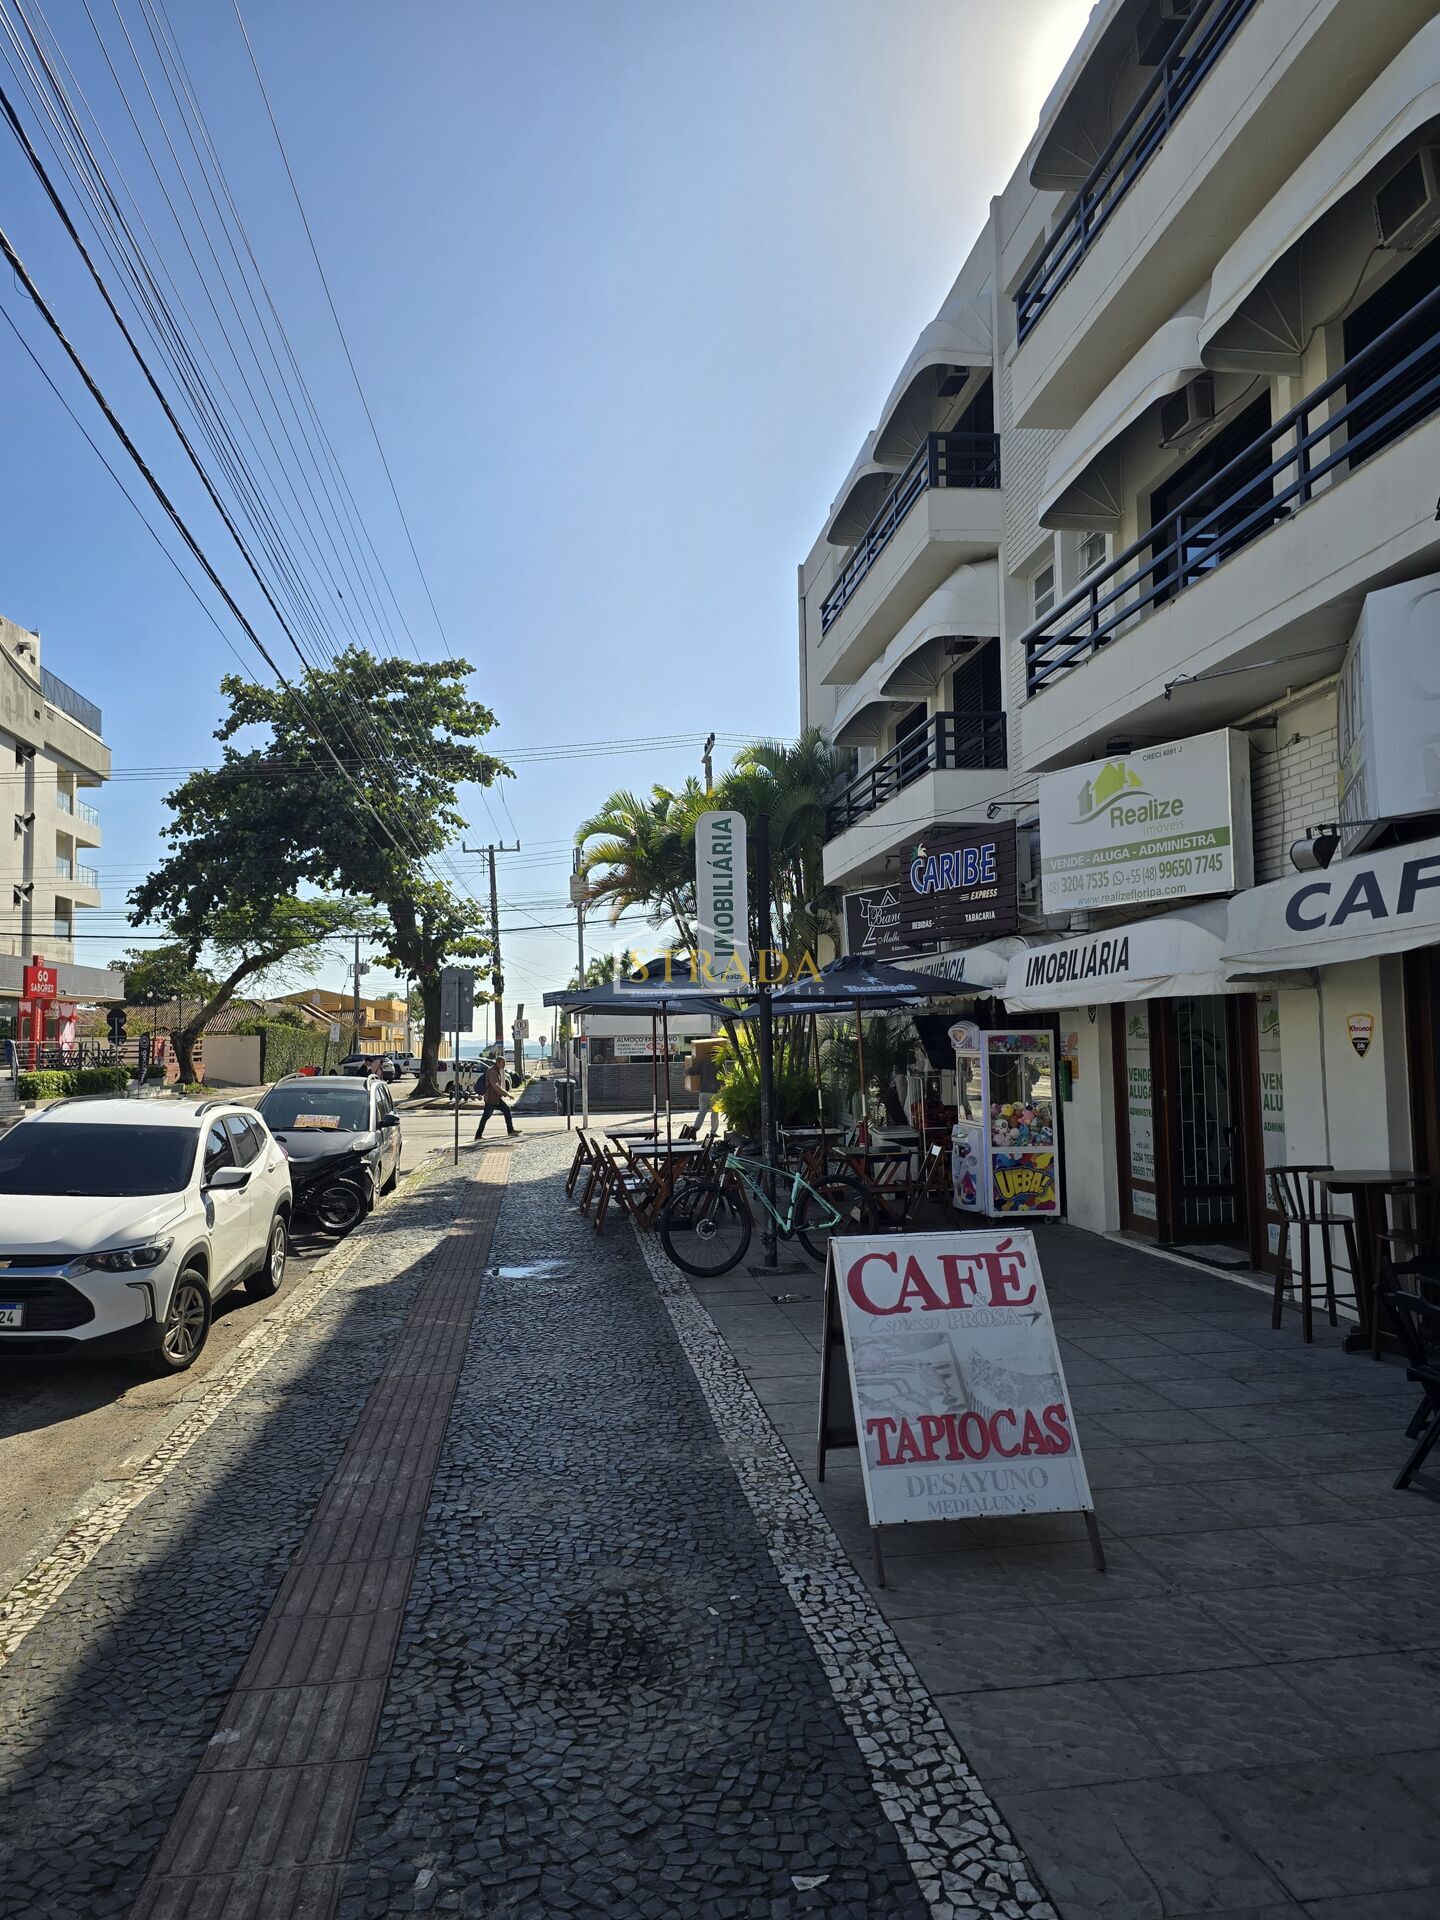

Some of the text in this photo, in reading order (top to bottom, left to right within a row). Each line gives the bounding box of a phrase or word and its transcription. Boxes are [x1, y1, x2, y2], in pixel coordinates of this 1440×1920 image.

[1142, 746, 1183, 762] CRECI 4091 J
[1109, 798, 1185, 828] Realize
[1050, 855, 1084, 872] VENDE
[1092, 848, 1130, 865] ALUGA
[1139, 833, 1216, 855] ADMINISTRA
[910, 843, 998, 895] CARIBE
[1046, 853, 1223, 897] (48) 3204 7535 +55 (48) 99650 7745
[707, 817, 734, 957] IMOBILIÁRIA
[970, 888, 998, 900] EXPRESS
[1077, 884, 1186, 906] www.realizefloripa.com
[964, 910, 996, 922] TABACARIA
[38, 970, 48, 982] 60
[1026, 935, 1130, 987] IMOBILIÁRIA
[30, 982, 54, 993] SABORES
[994, 1166, 1052, 1199] UEBA!
[846, 1237, 1038, 1316] CAFÉ
[868, 1308, 1022, 1334] Espresso PROSA
[866, 1404, 1072, 1466] TAPIOCAS
[906, 1466, 1048, 1498] DESAYUNO
[928, 1494, 1036, 1516] MEDIALUNAS
